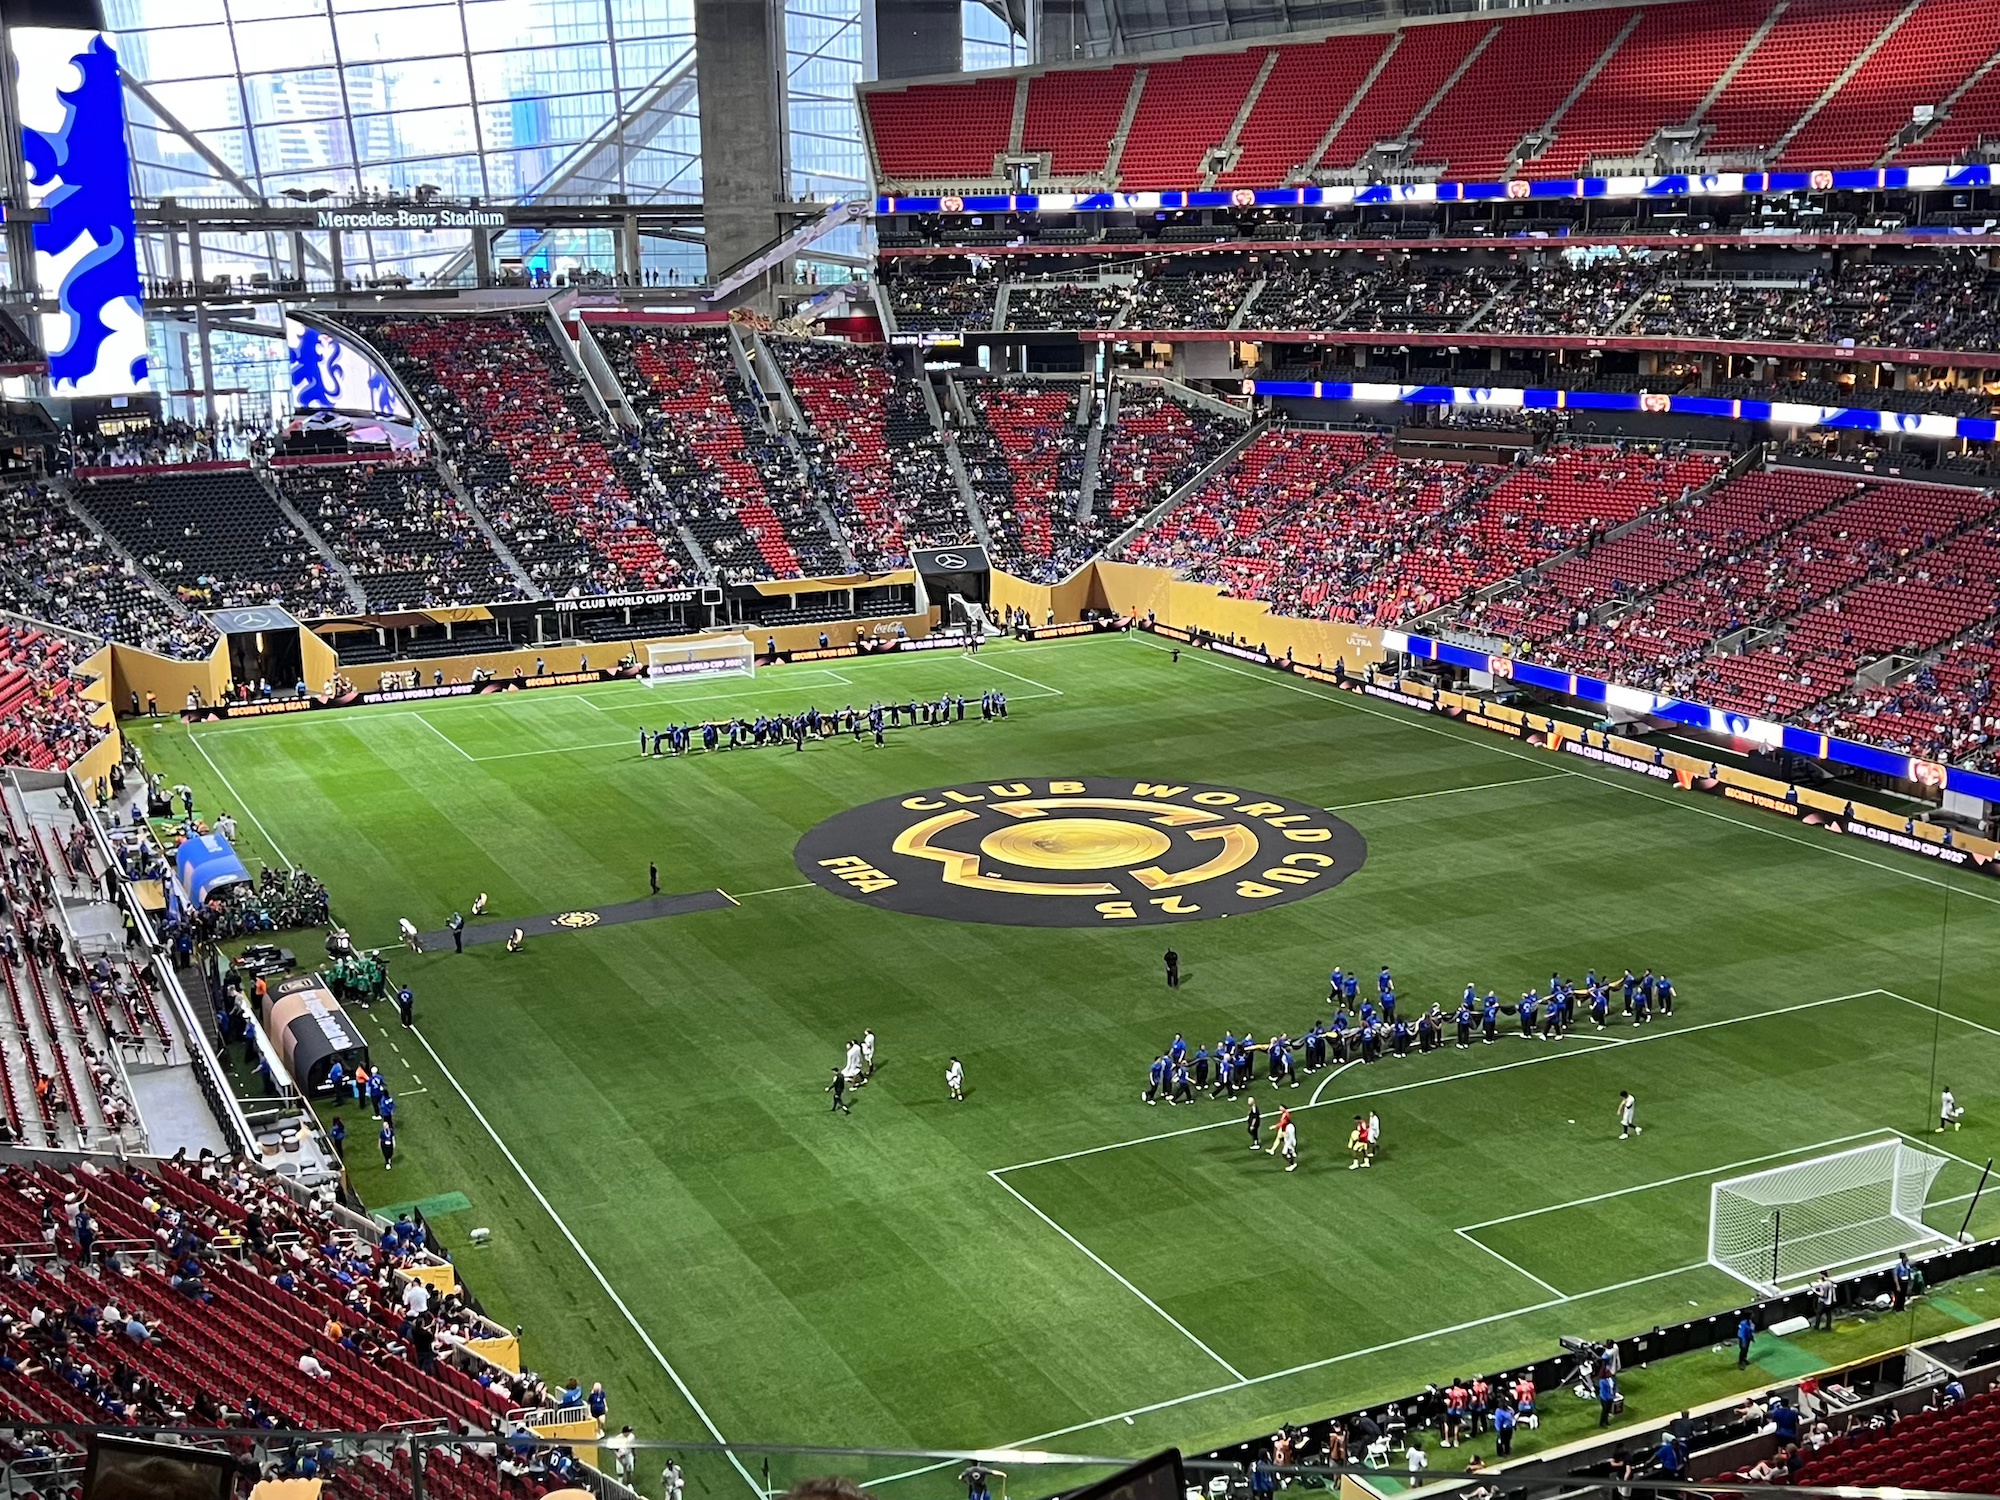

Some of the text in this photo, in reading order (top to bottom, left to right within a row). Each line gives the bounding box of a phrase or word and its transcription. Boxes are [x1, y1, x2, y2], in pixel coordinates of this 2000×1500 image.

[318, 210, 505, 227] Mercedes-Benz Stadium
[555, 602, 578, 611] FIFA
[579, 599, 606, 609] CLUB
[607, 596, 643, 607] WORLD
[645, 593, 666, 604] CUP
[1346, 637, 1372, 647] ULTRA
[227, 705, 260, 716] SECURE
[261, 703, 285, 713] YOUR
[1566, 741, 1583, 755] FIFA
[1583, 746, 1603, 760] CLUB
[1603, 752, 1631, 769] WORLD
[1632, 760, 1648, 773] CUP
[1848, 822, 1867, 836] FIFA
[1867, 828, 1889, 841] CLUB
[1889, 834, 1921, 851] WORLD
[1921, 843, 1940, 856] CUP
[817, 781, 1334, 920] CLUB WORLD CUP 25 FIFA
